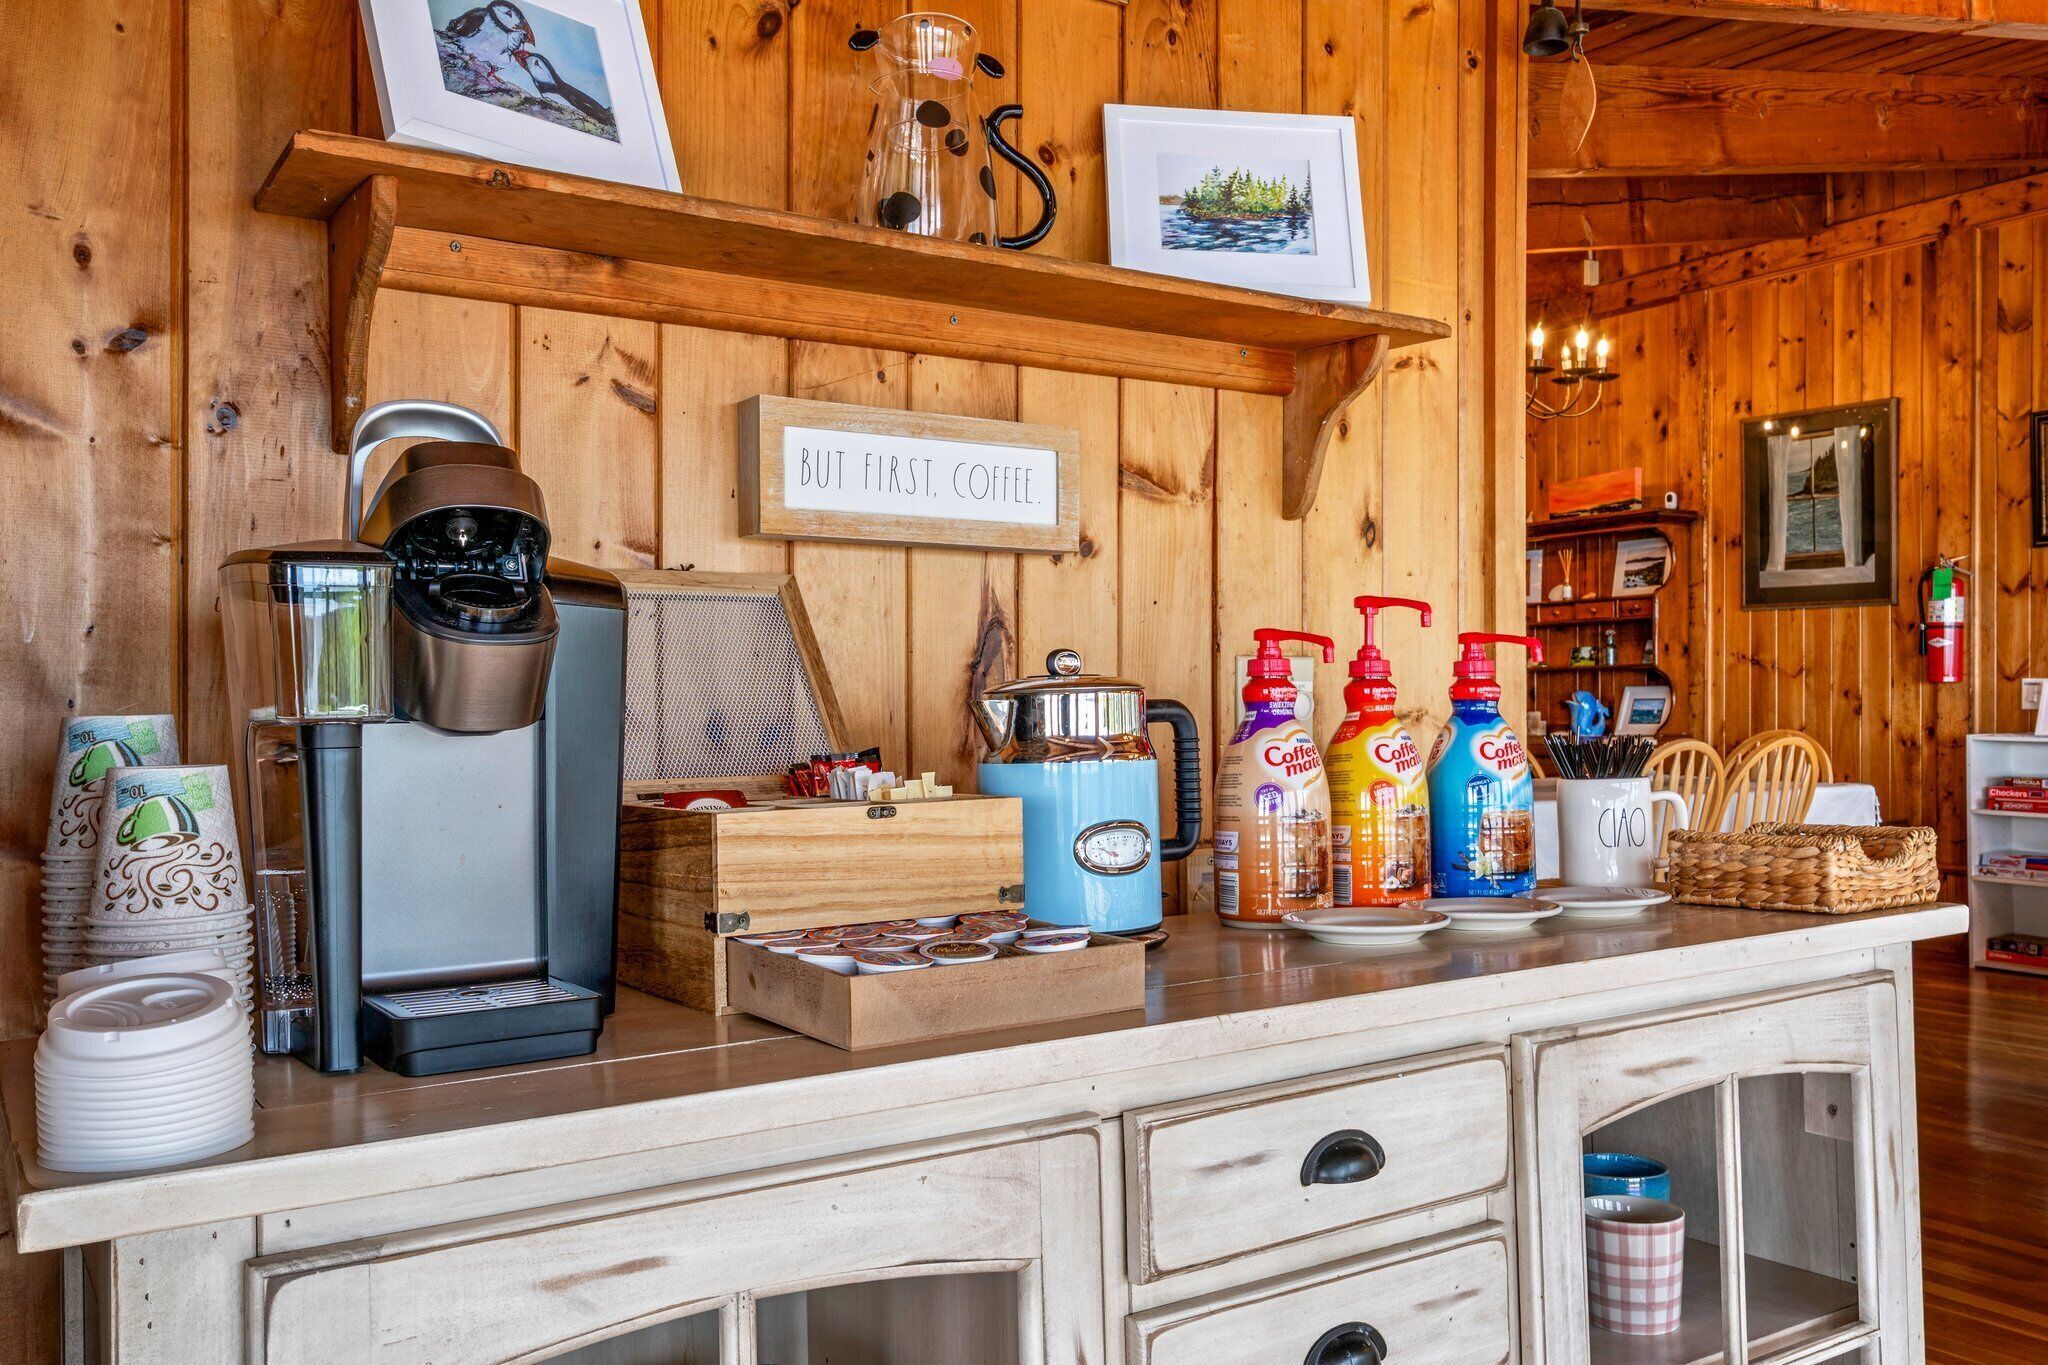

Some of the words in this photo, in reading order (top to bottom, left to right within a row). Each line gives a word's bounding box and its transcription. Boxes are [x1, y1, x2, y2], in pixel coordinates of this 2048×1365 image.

[800, 447, 845, 490] BUT
[864, 453, 937, 499] FIRST,
[953, 462, 1042, 504] COFFEE.
[80, 730, 96, 743] 10
[1264, 744, 1317, 767] Coffee
[1285, 756, 1321, 777] mate
[129, 785, 147, 798] 10
[1990, 788, 2027, 798] Checkers
[1598, 807, 1646, 848] CIAO
